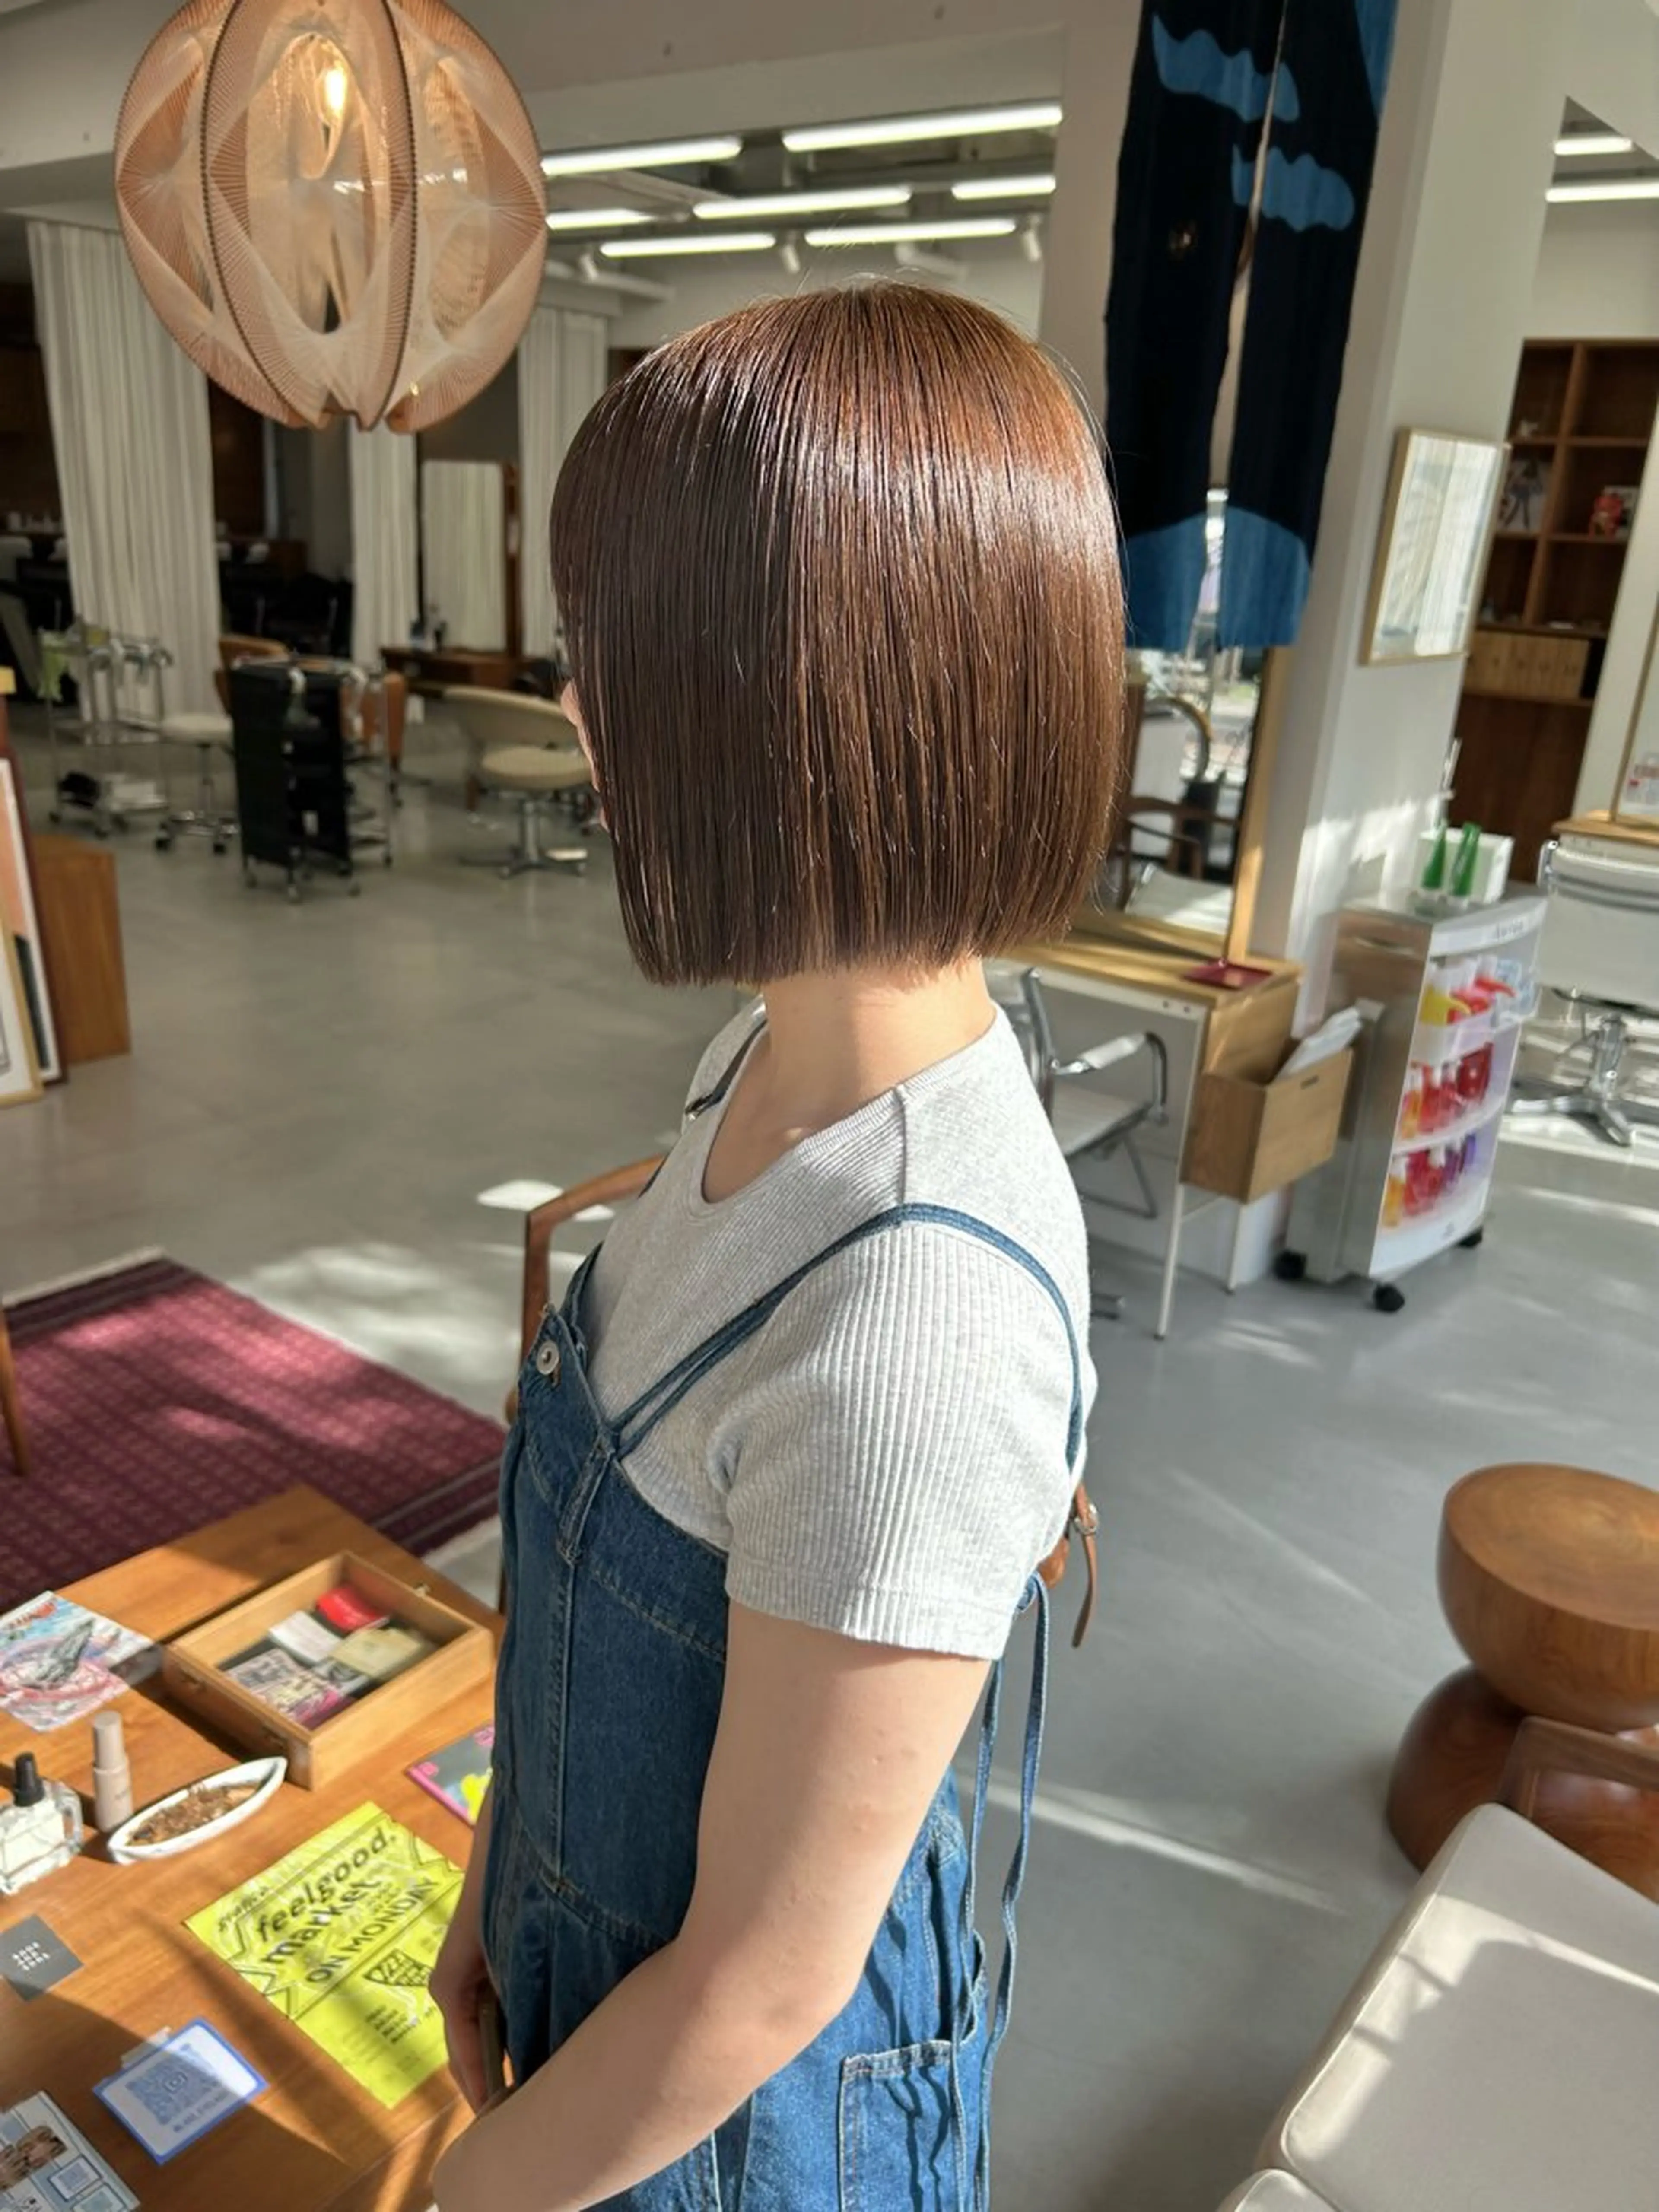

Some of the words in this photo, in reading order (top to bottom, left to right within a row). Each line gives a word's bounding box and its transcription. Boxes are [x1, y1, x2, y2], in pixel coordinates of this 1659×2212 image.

[257, 1827, 396, 1942] feelgood.
[261, 1880, 383, 1964] market
[305, 1954, 351, 1983] ON
[339, 1877, 439, 1952] MONDAY
